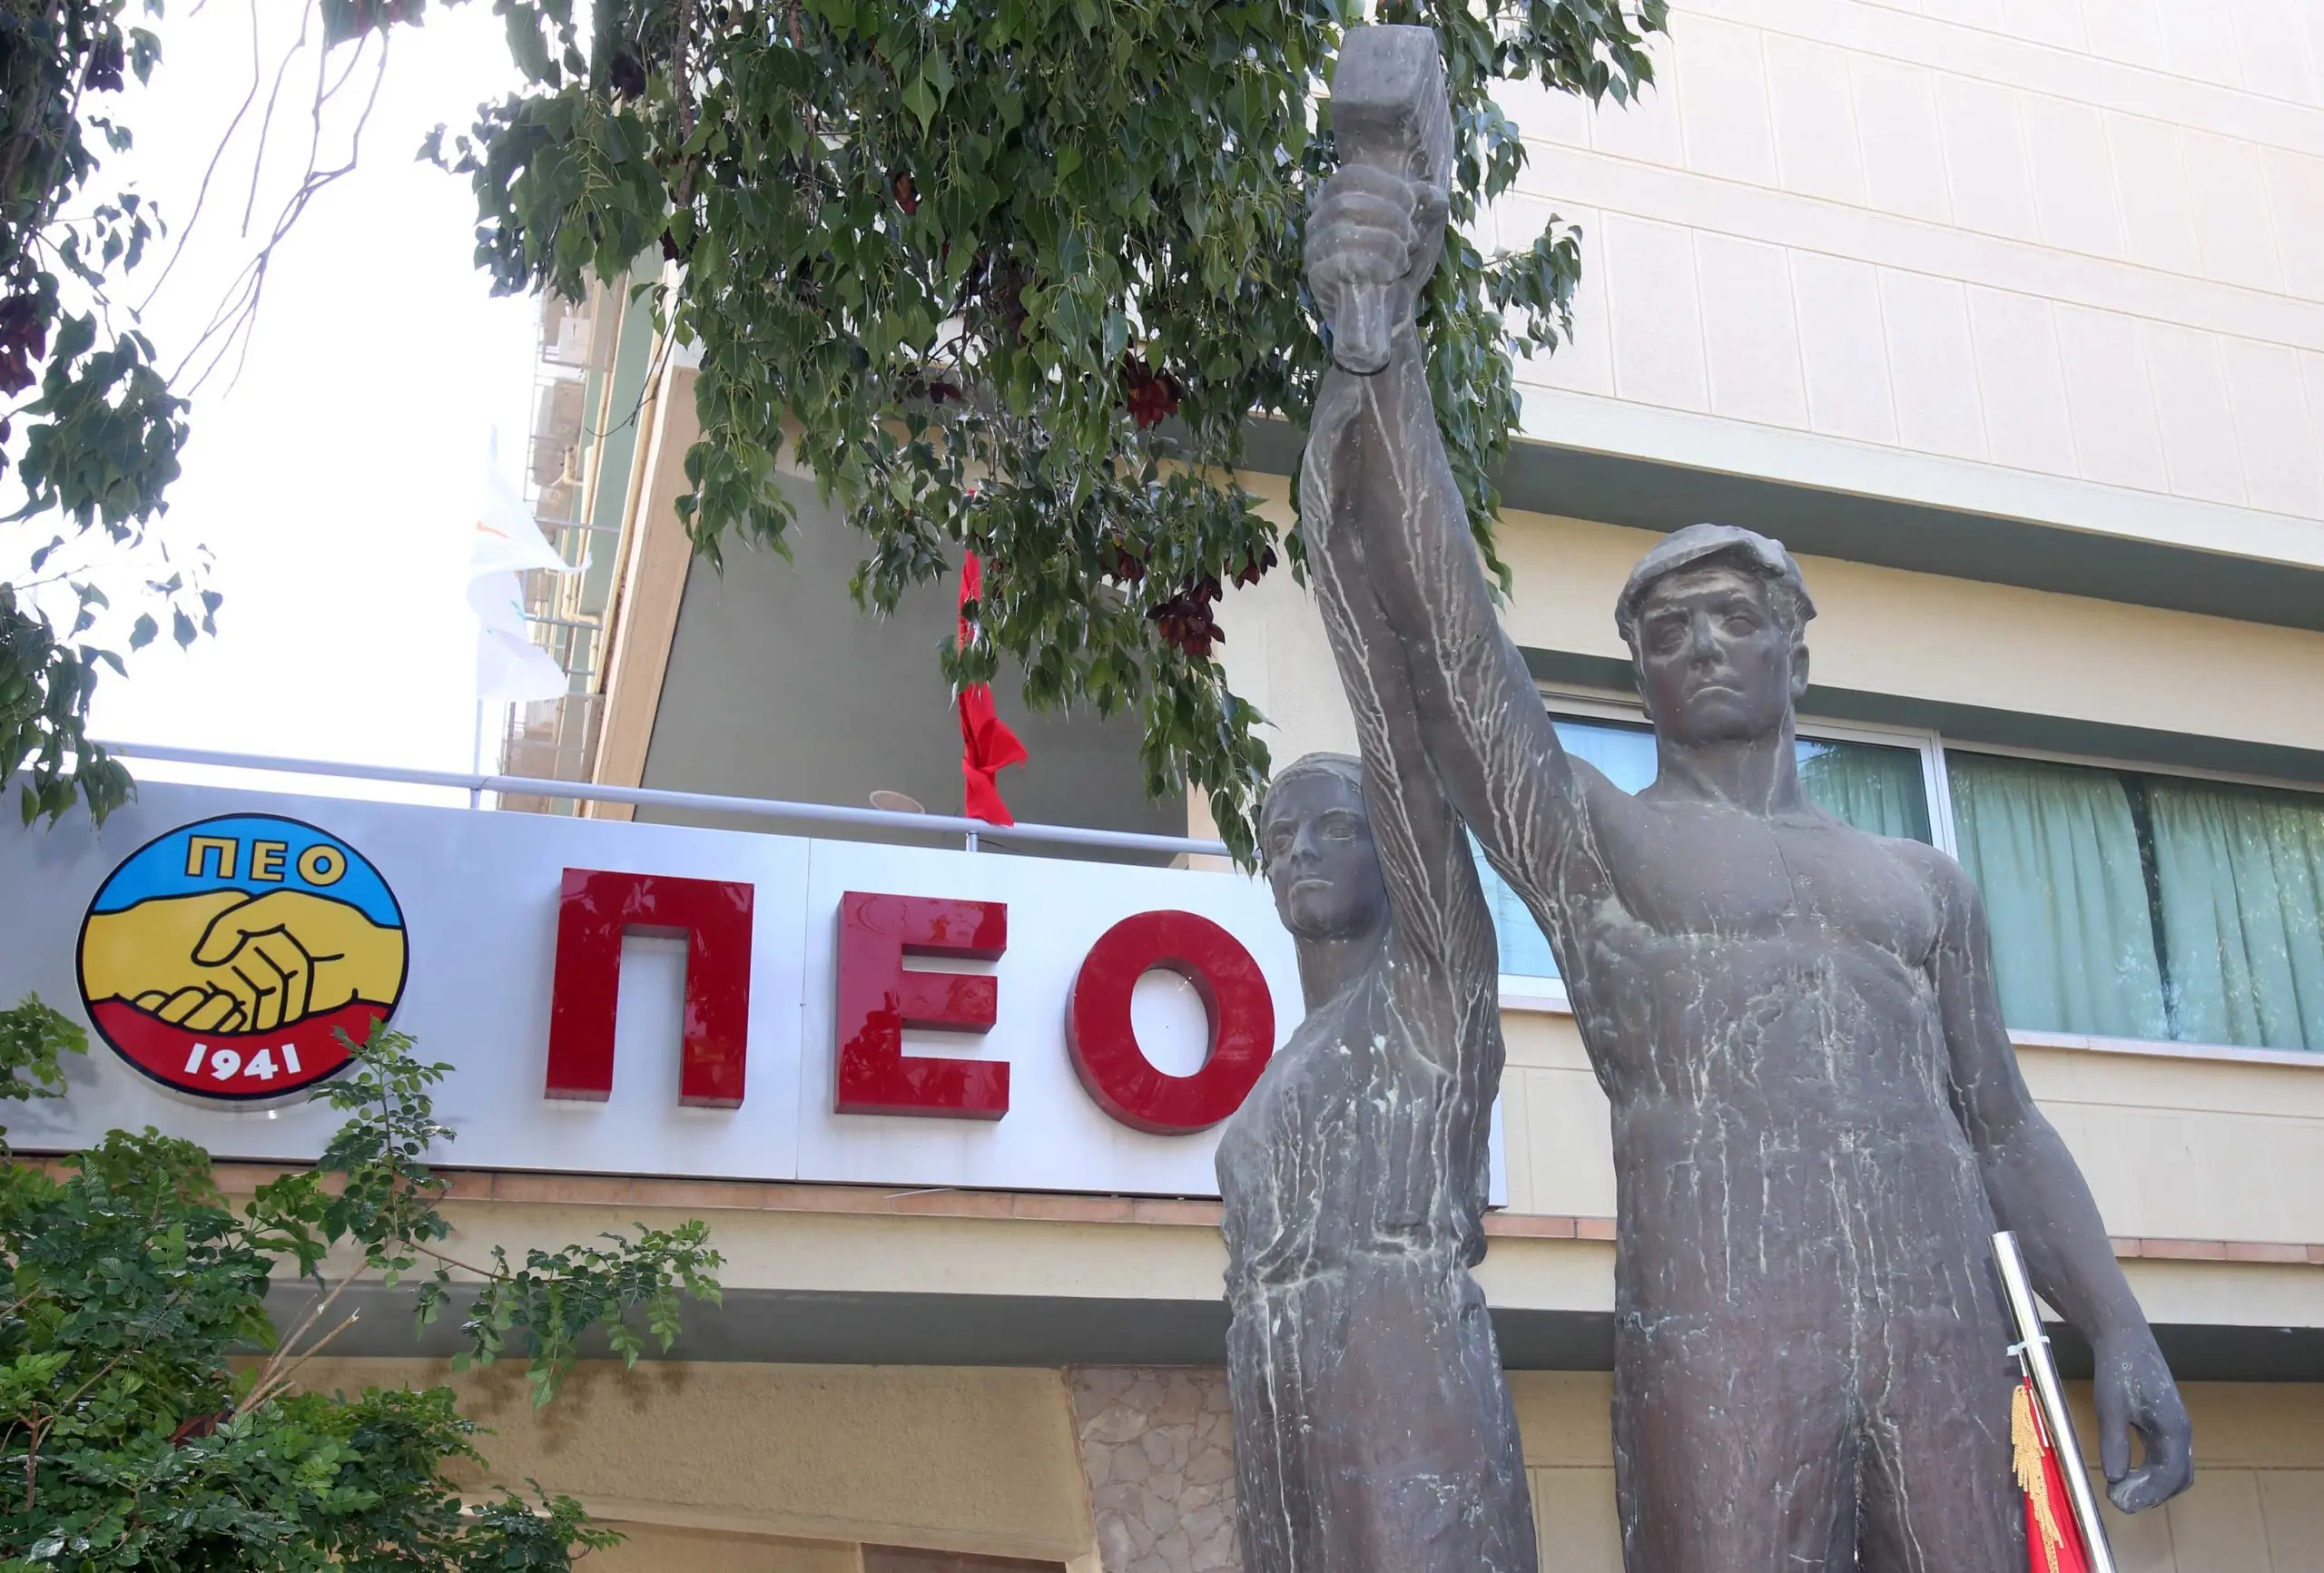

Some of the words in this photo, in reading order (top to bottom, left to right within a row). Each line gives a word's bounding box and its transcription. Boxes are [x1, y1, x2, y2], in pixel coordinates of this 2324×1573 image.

[184, 834, 348, 886] ΠΕΟ
[545, 868, 1275, 1136] ΠΕΟ
[184, 1043, 301, 1080] 1941
